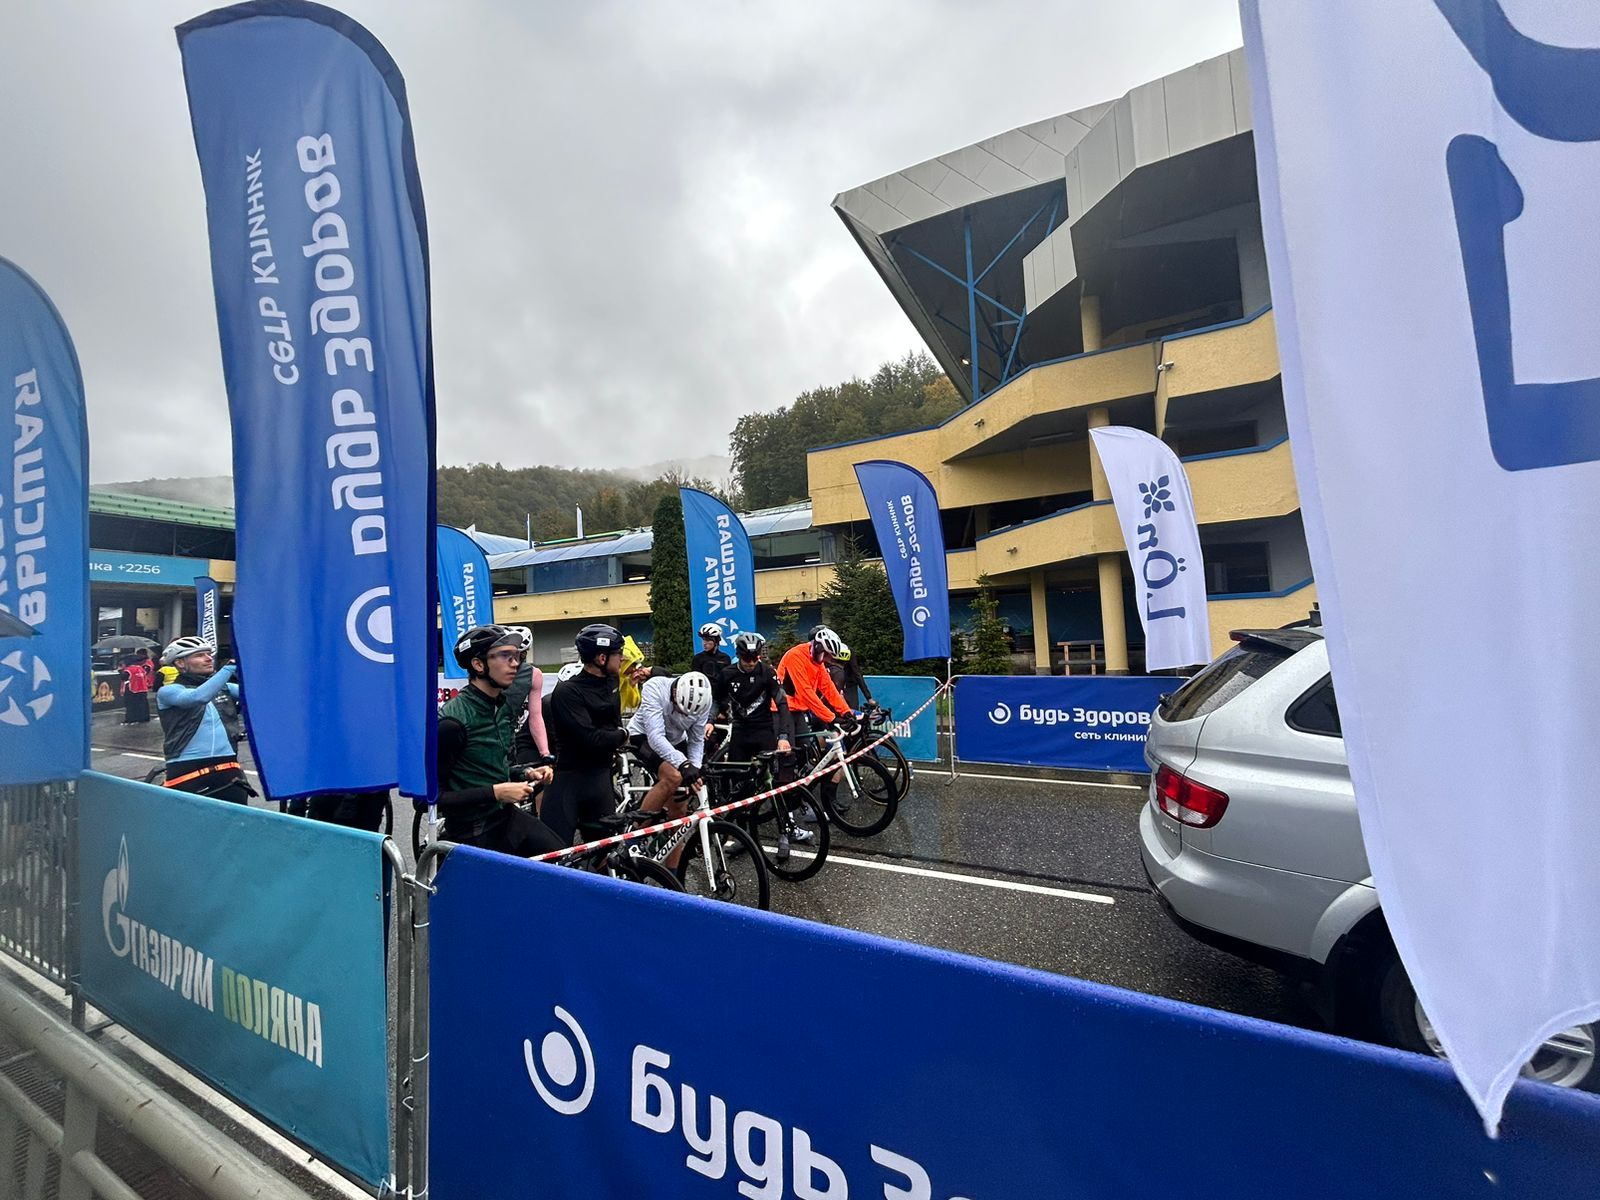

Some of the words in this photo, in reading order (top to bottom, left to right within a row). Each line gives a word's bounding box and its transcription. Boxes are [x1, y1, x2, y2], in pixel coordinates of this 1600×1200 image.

[117, 563, 161, 574] +2256
[1072, 707, 1152, 728] Здоров
[1074, 731, 1101, 740] сеть
[656, 821, 693, 861] COLNAGO
[129, 920, 215, 1012] ГАЗПРОМ
[221, 966, 324, 1069] ПОЛЯНА
